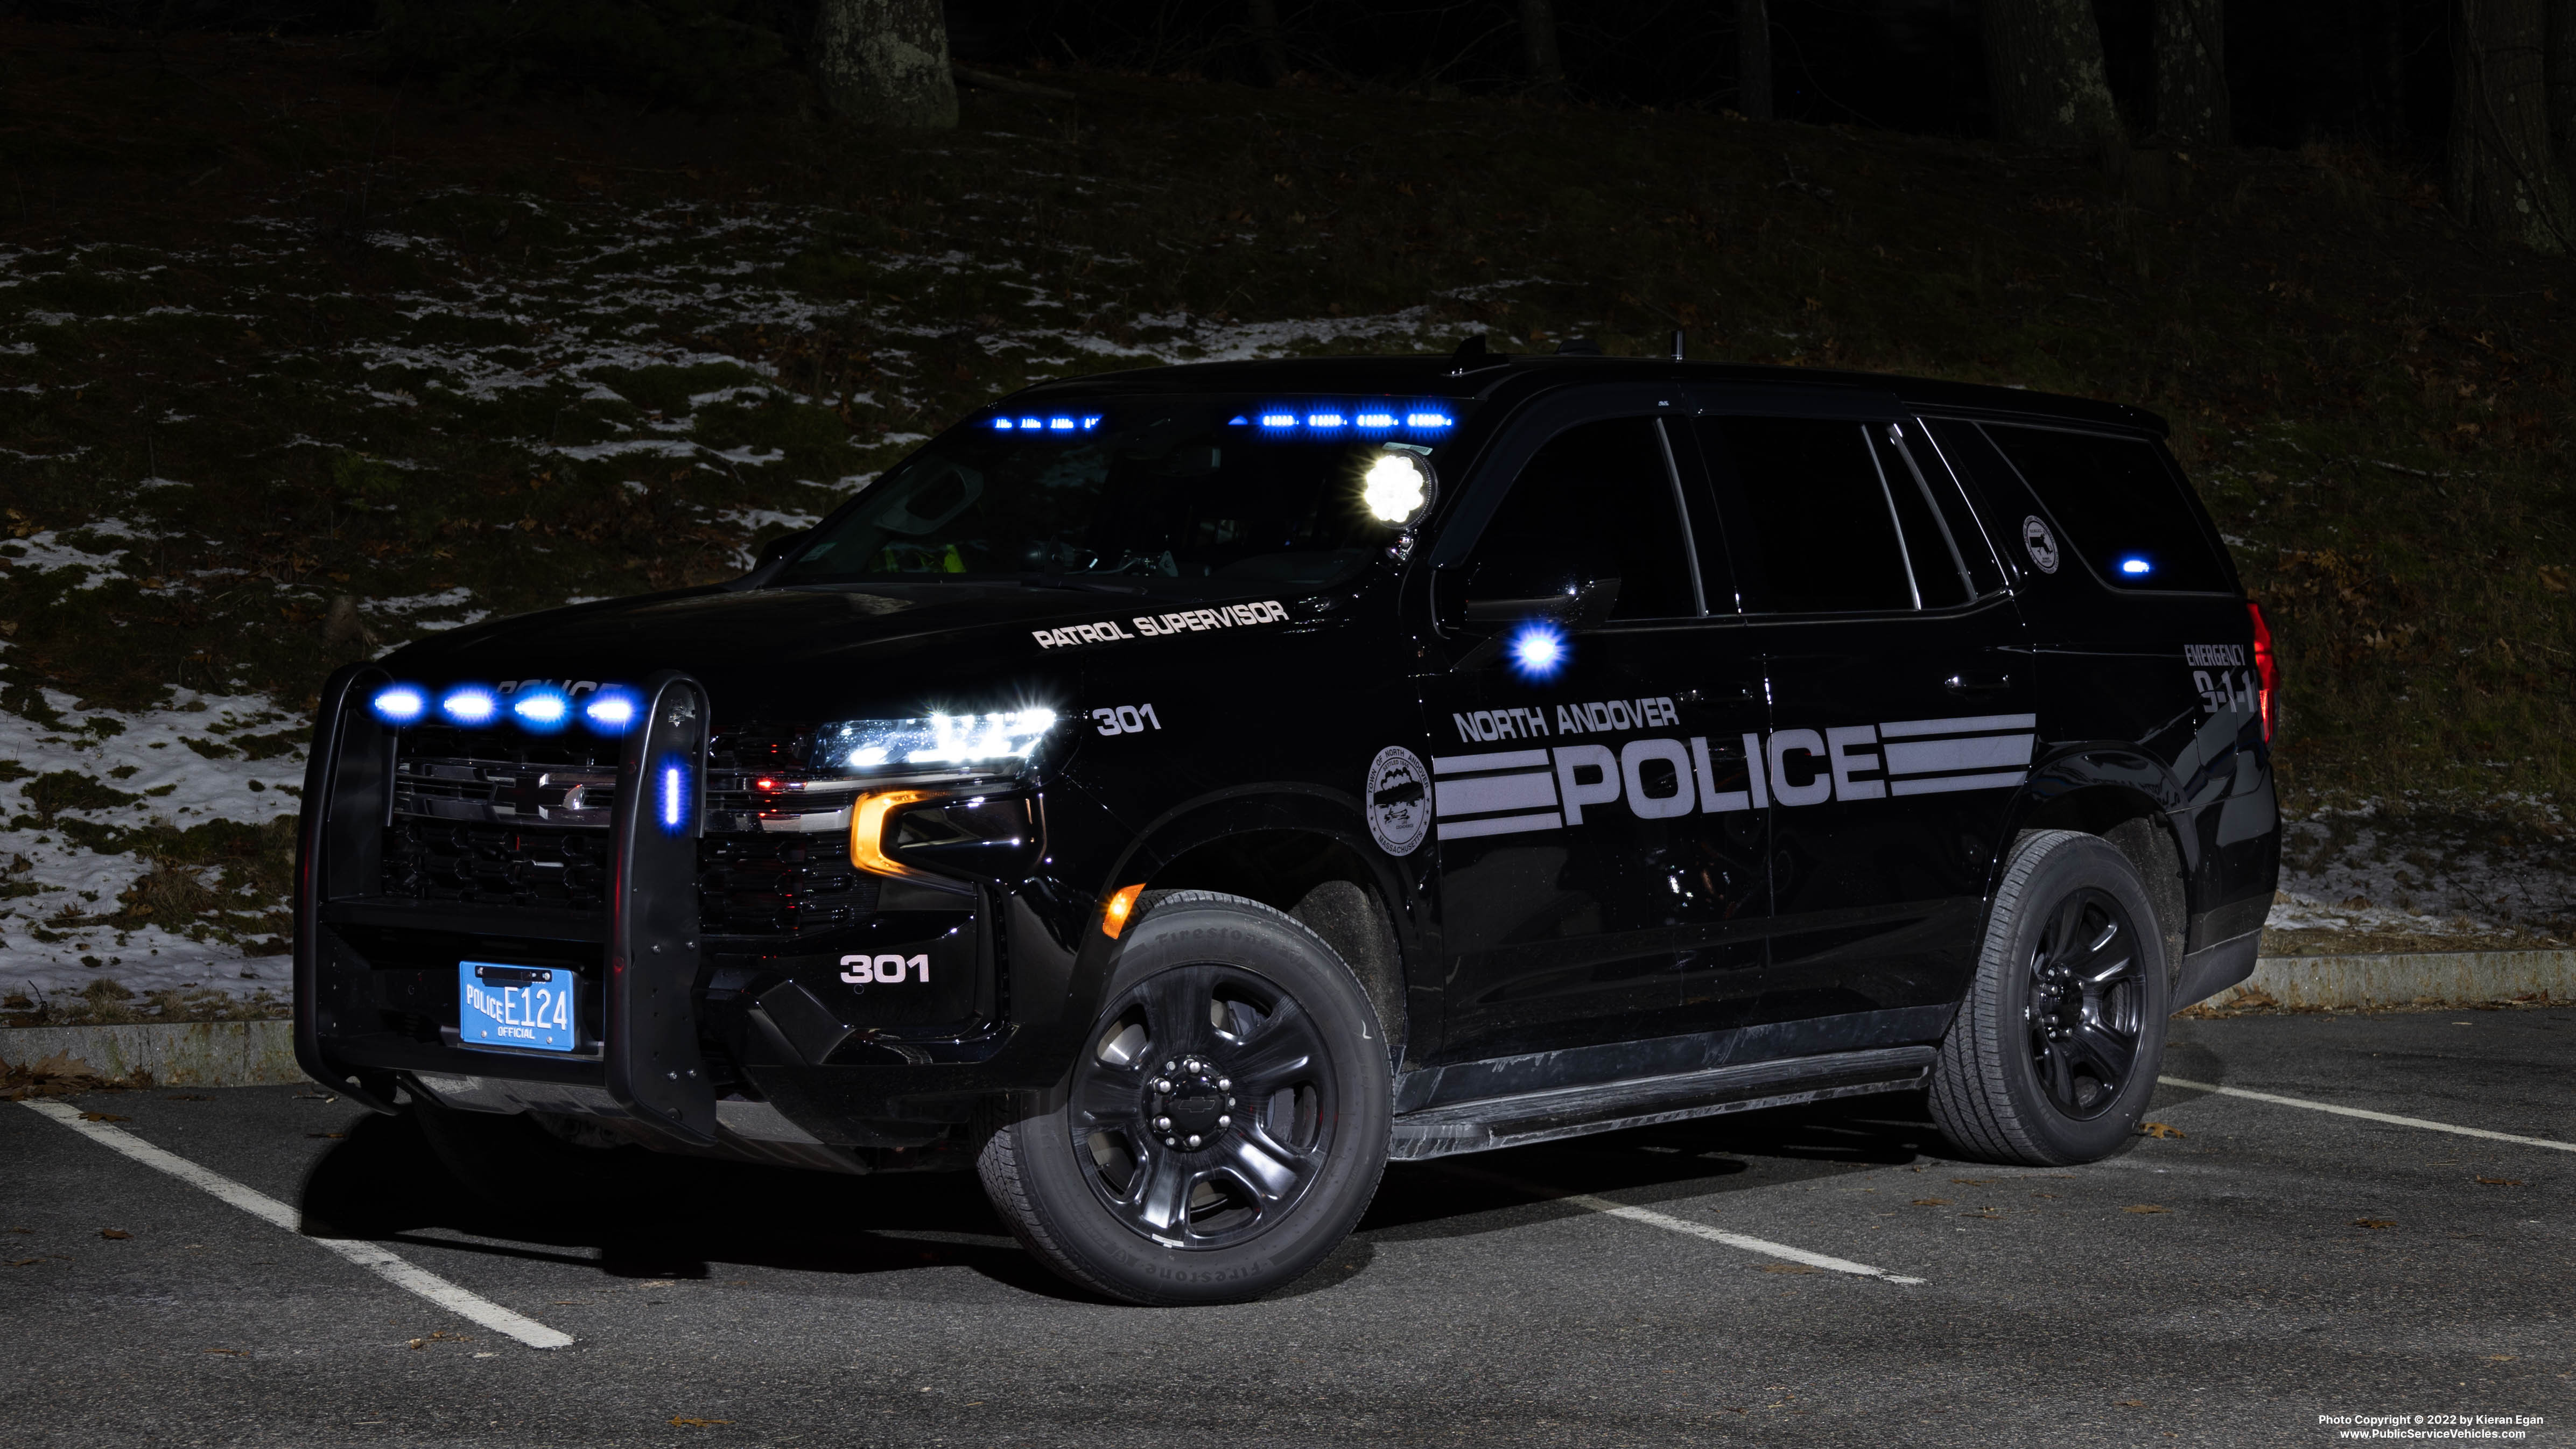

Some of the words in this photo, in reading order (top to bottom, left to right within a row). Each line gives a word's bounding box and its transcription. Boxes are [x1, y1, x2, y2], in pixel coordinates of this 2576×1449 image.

[1032, 621, 1135, 649] PATROL
[1133, 601, 1288, 636] SUPERVISOR
[2184, 644, 2246, 666] EMERGENCY
[2193, 670, 2255, 713] 9-1-1
[1092, 704, 1161, 736] 301
[1452, 707, 1549, 743] NORTH
[1556, 697, 1680, 735] ANDOVER
[1368, 769, 1376, 793] TOWN
[1376, 756, 1382, 766] OF
[1385, 749, 1404, 758] NORTH
[1408, 755, 1429, 789] ANDOVER
[1382, 759, 1399, 771] SETTLED
[1553, 724, 1886, 826] POLICE
[1378, 831, 1423, 854] MASSACHUSETTS
[840, 954, 930, 983] 301
[466, 984, 503, 1024] POLICE
[504, 986, 567, 1031] E124
[498, 1026, 536, 1039] OFFICIAL
